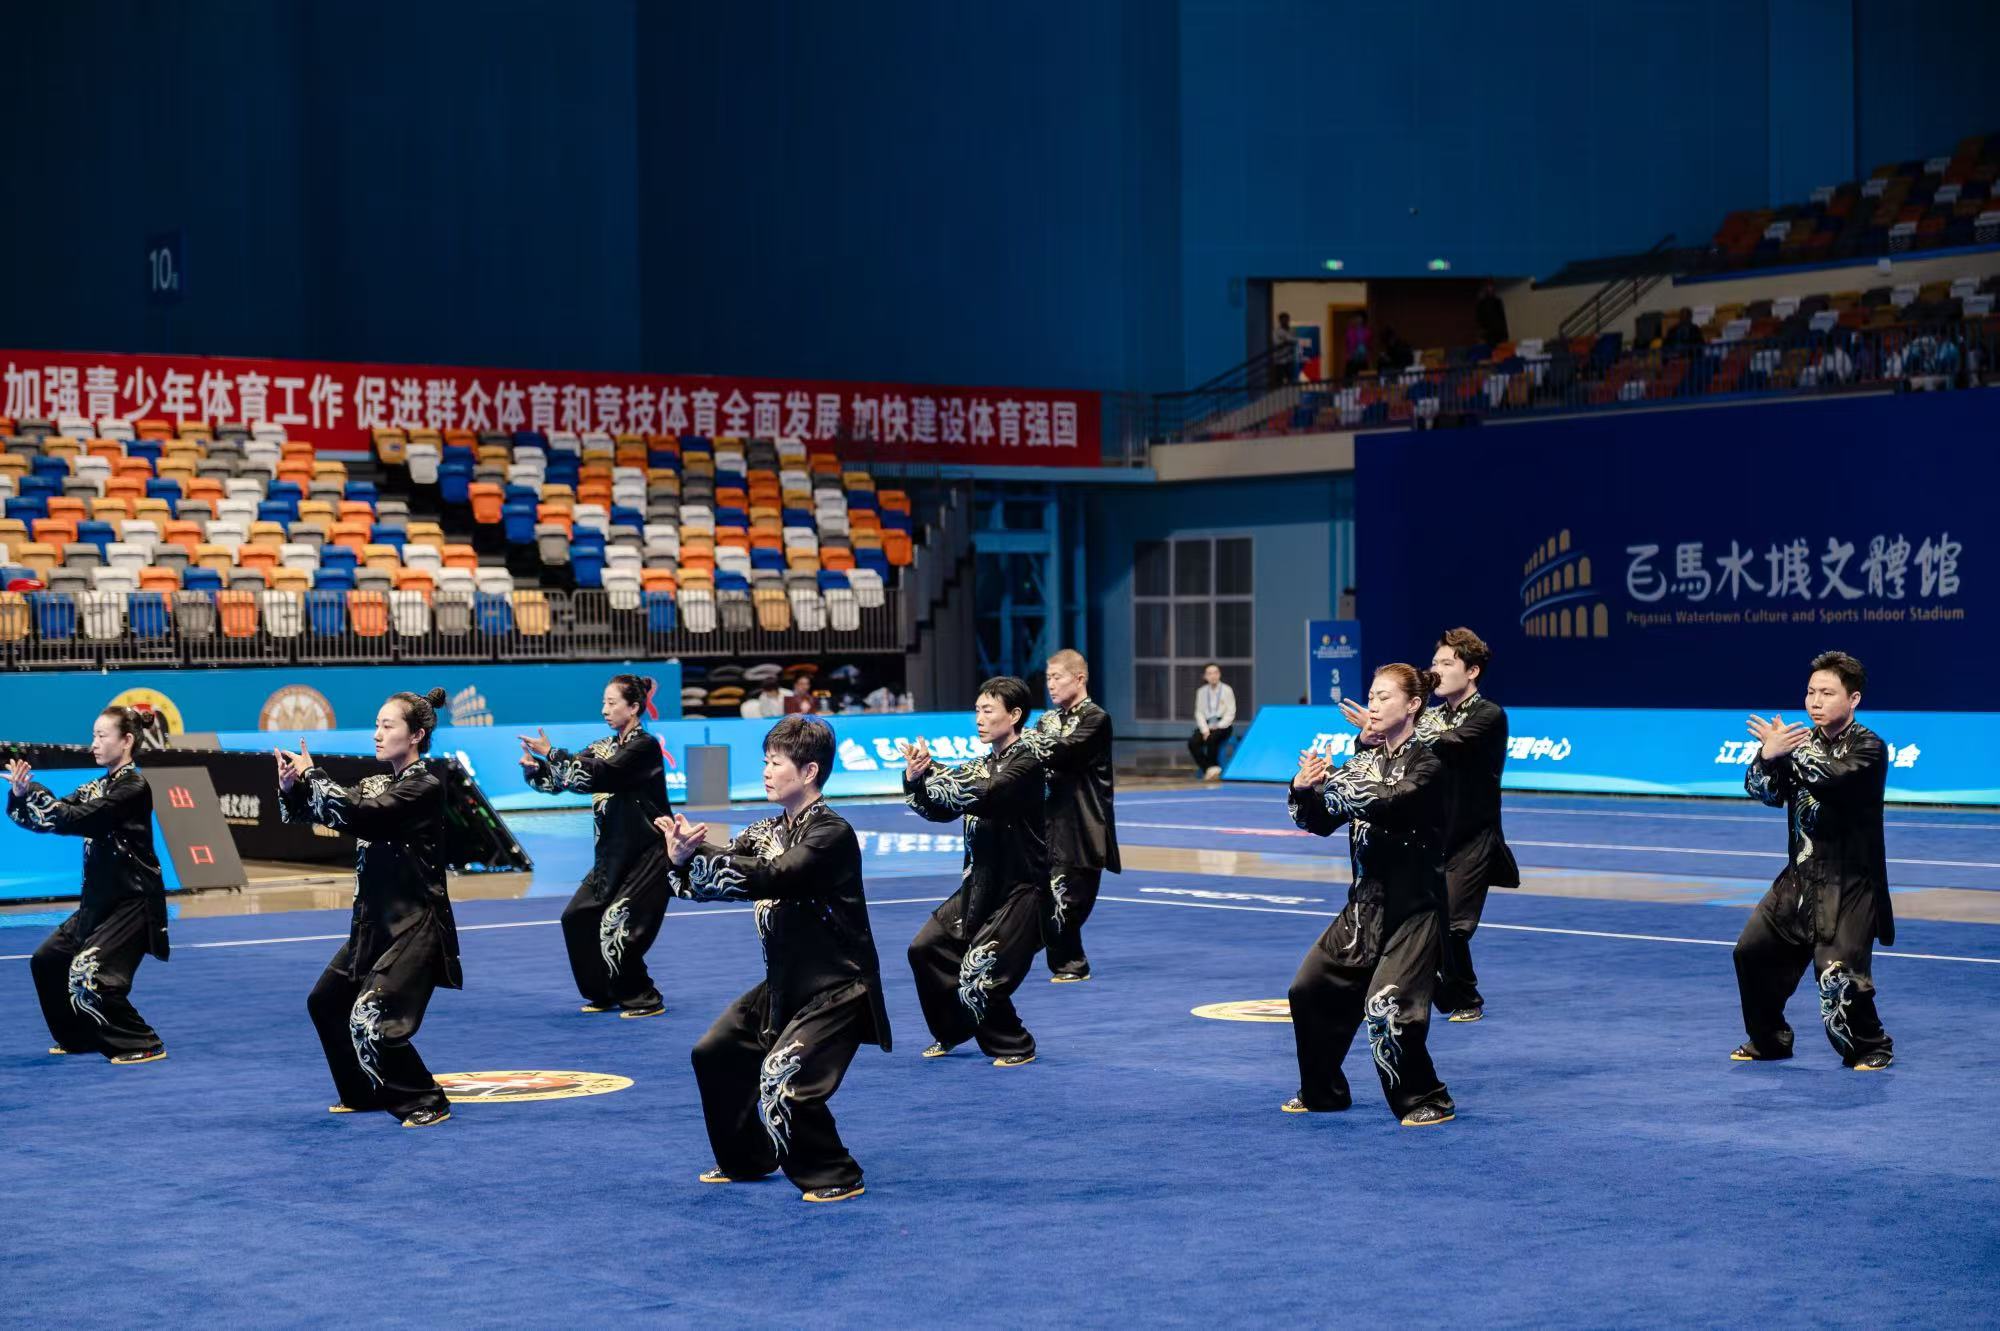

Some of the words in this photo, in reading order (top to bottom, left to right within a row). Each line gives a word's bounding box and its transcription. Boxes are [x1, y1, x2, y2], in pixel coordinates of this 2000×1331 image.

[1626, 609, 1672, 626] Pegasus
[1676, 608, 1741, 624] Watertown
[1744, 607, 1787, 623] Culture
[1791, 607, 1815, 622] and
[1819, 607, 1859, 625] Sports
[1863, 605, 1905, 621] Indoor
[1909, 604, 1964, 620] Stadium
